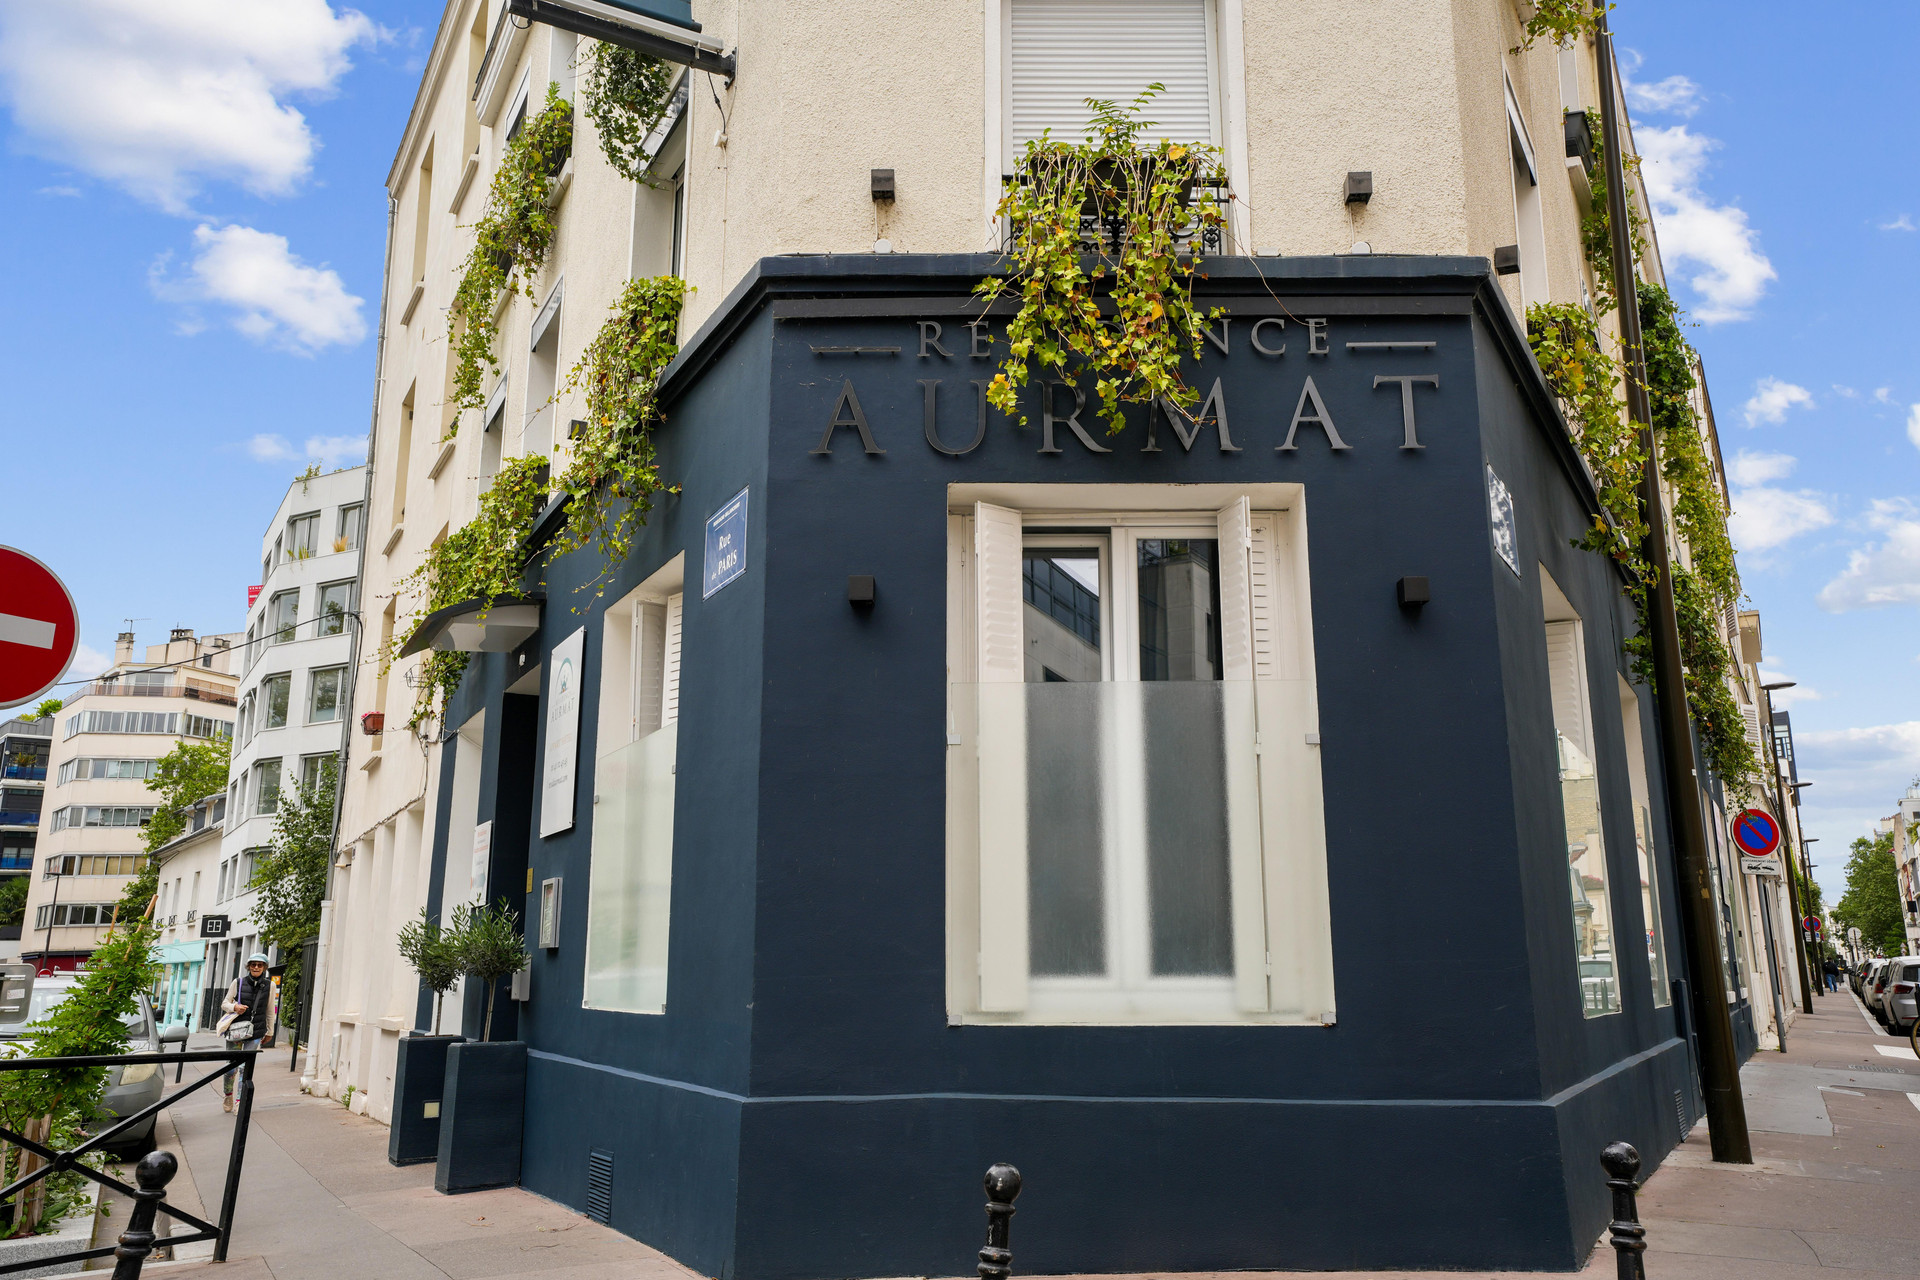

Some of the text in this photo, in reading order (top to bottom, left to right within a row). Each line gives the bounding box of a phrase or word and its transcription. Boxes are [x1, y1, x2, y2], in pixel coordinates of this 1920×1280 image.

[917, 318, 1329, 357] RENCE
[808, 373, 1440, 455] AURMAT
[718, 533, 732, 551] Rue
[717, 549, 738, 576] PARIS
